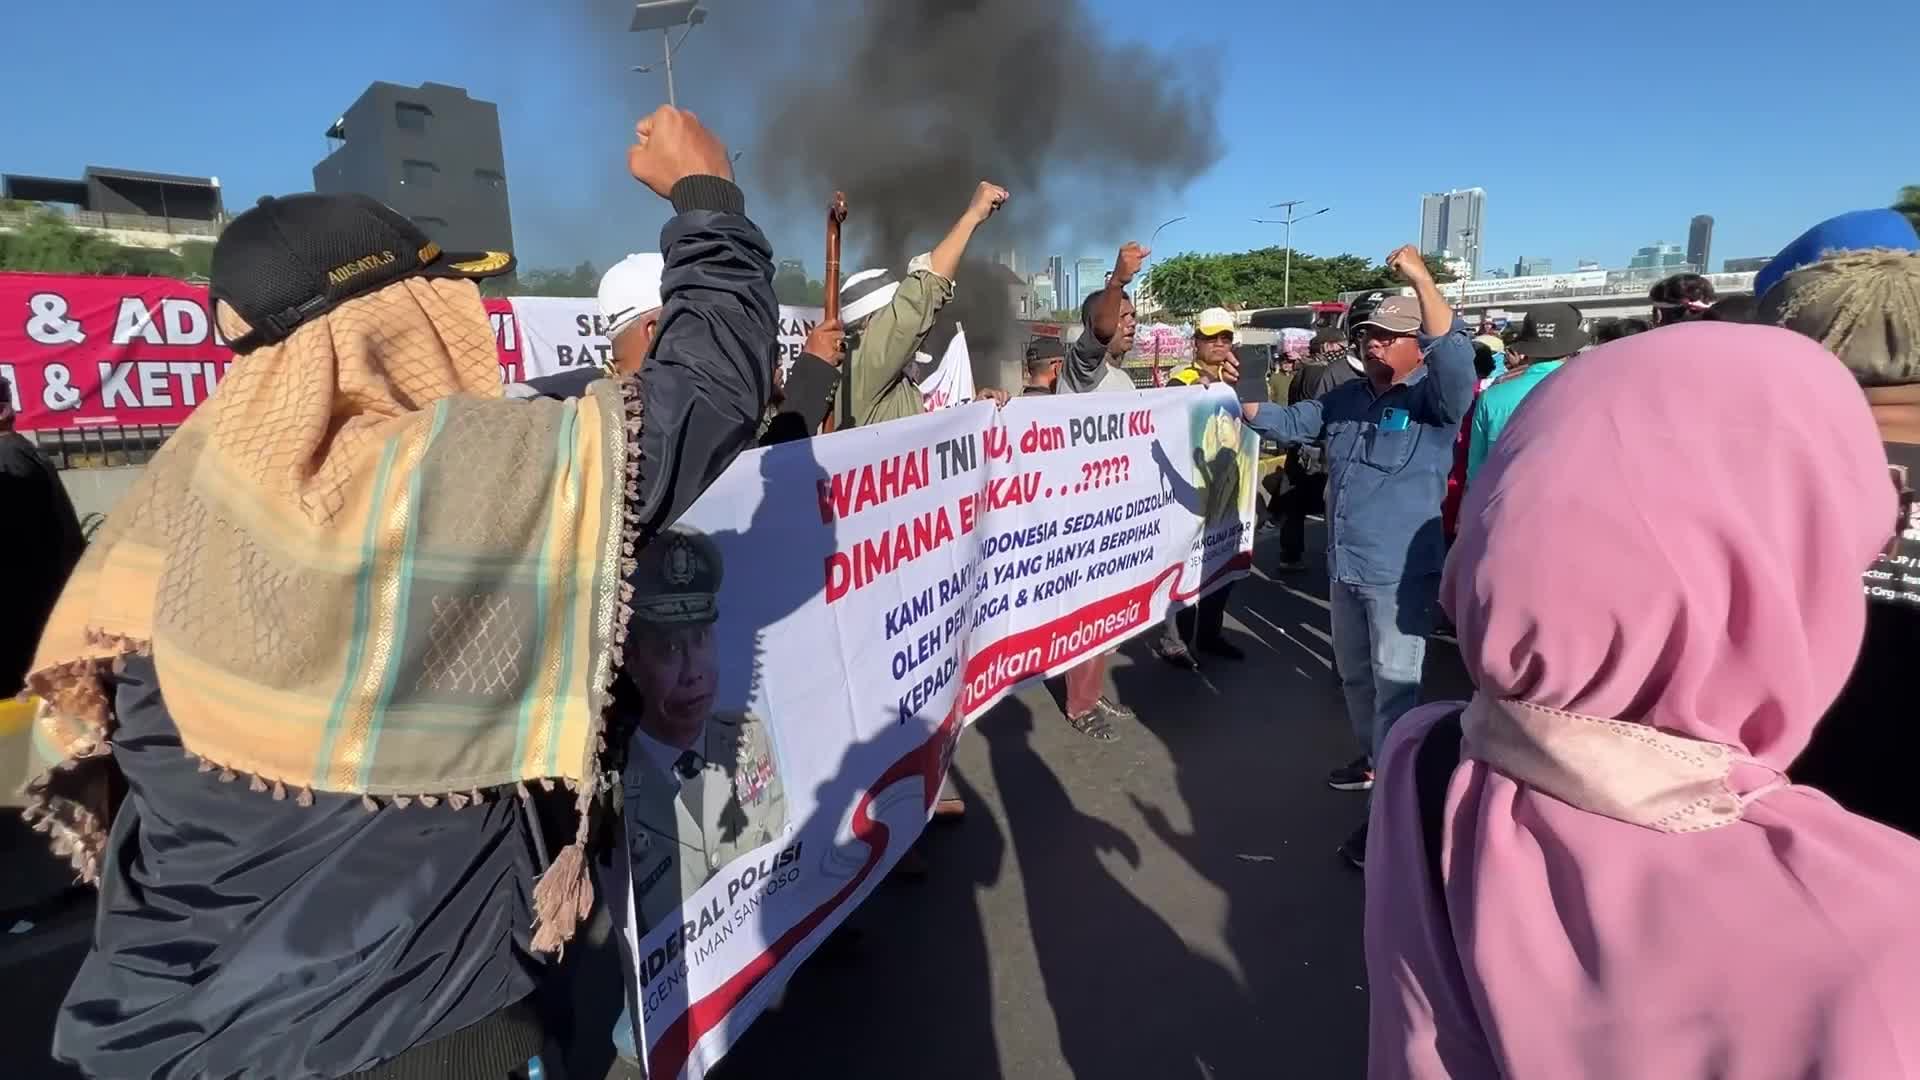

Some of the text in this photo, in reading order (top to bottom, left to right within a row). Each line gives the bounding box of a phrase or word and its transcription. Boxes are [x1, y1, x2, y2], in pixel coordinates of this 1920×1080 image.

[26, 293, 87, 345] &
[112, 297, 228, 346] AD
[43, 363, 82, 411] &
[816, 447, 930, 526] WAHAI
[935, 433, 977, 480] TNI
[1020, 421, 1066, 454] dan
[1069, 412, 1125, 447] POLRI
[1128, 409, 1155, 438] KU.
[823, 505, 954, 605] DIMANA
[885, 586, 934, 641] KAMI
[1062, 505, 1123, 536] SEDANG
[1014, 588, 1028, 609] &
[1086, 545, 1154, 583] KRONINYA
[892, 624, 941, 680] OLEH
[993, 554, 1042, 586] YANG
[1045, 539, 1095, 571] HANYA
[1099, 519, 1161, 551] BERPIHAK
[1047, 599, 1141, 663] indonesia
[727, 841, 803, 906] POLISI
[693, 920, 734, 966] IMAN
[734, 867, 801, 927] SANTOSO
